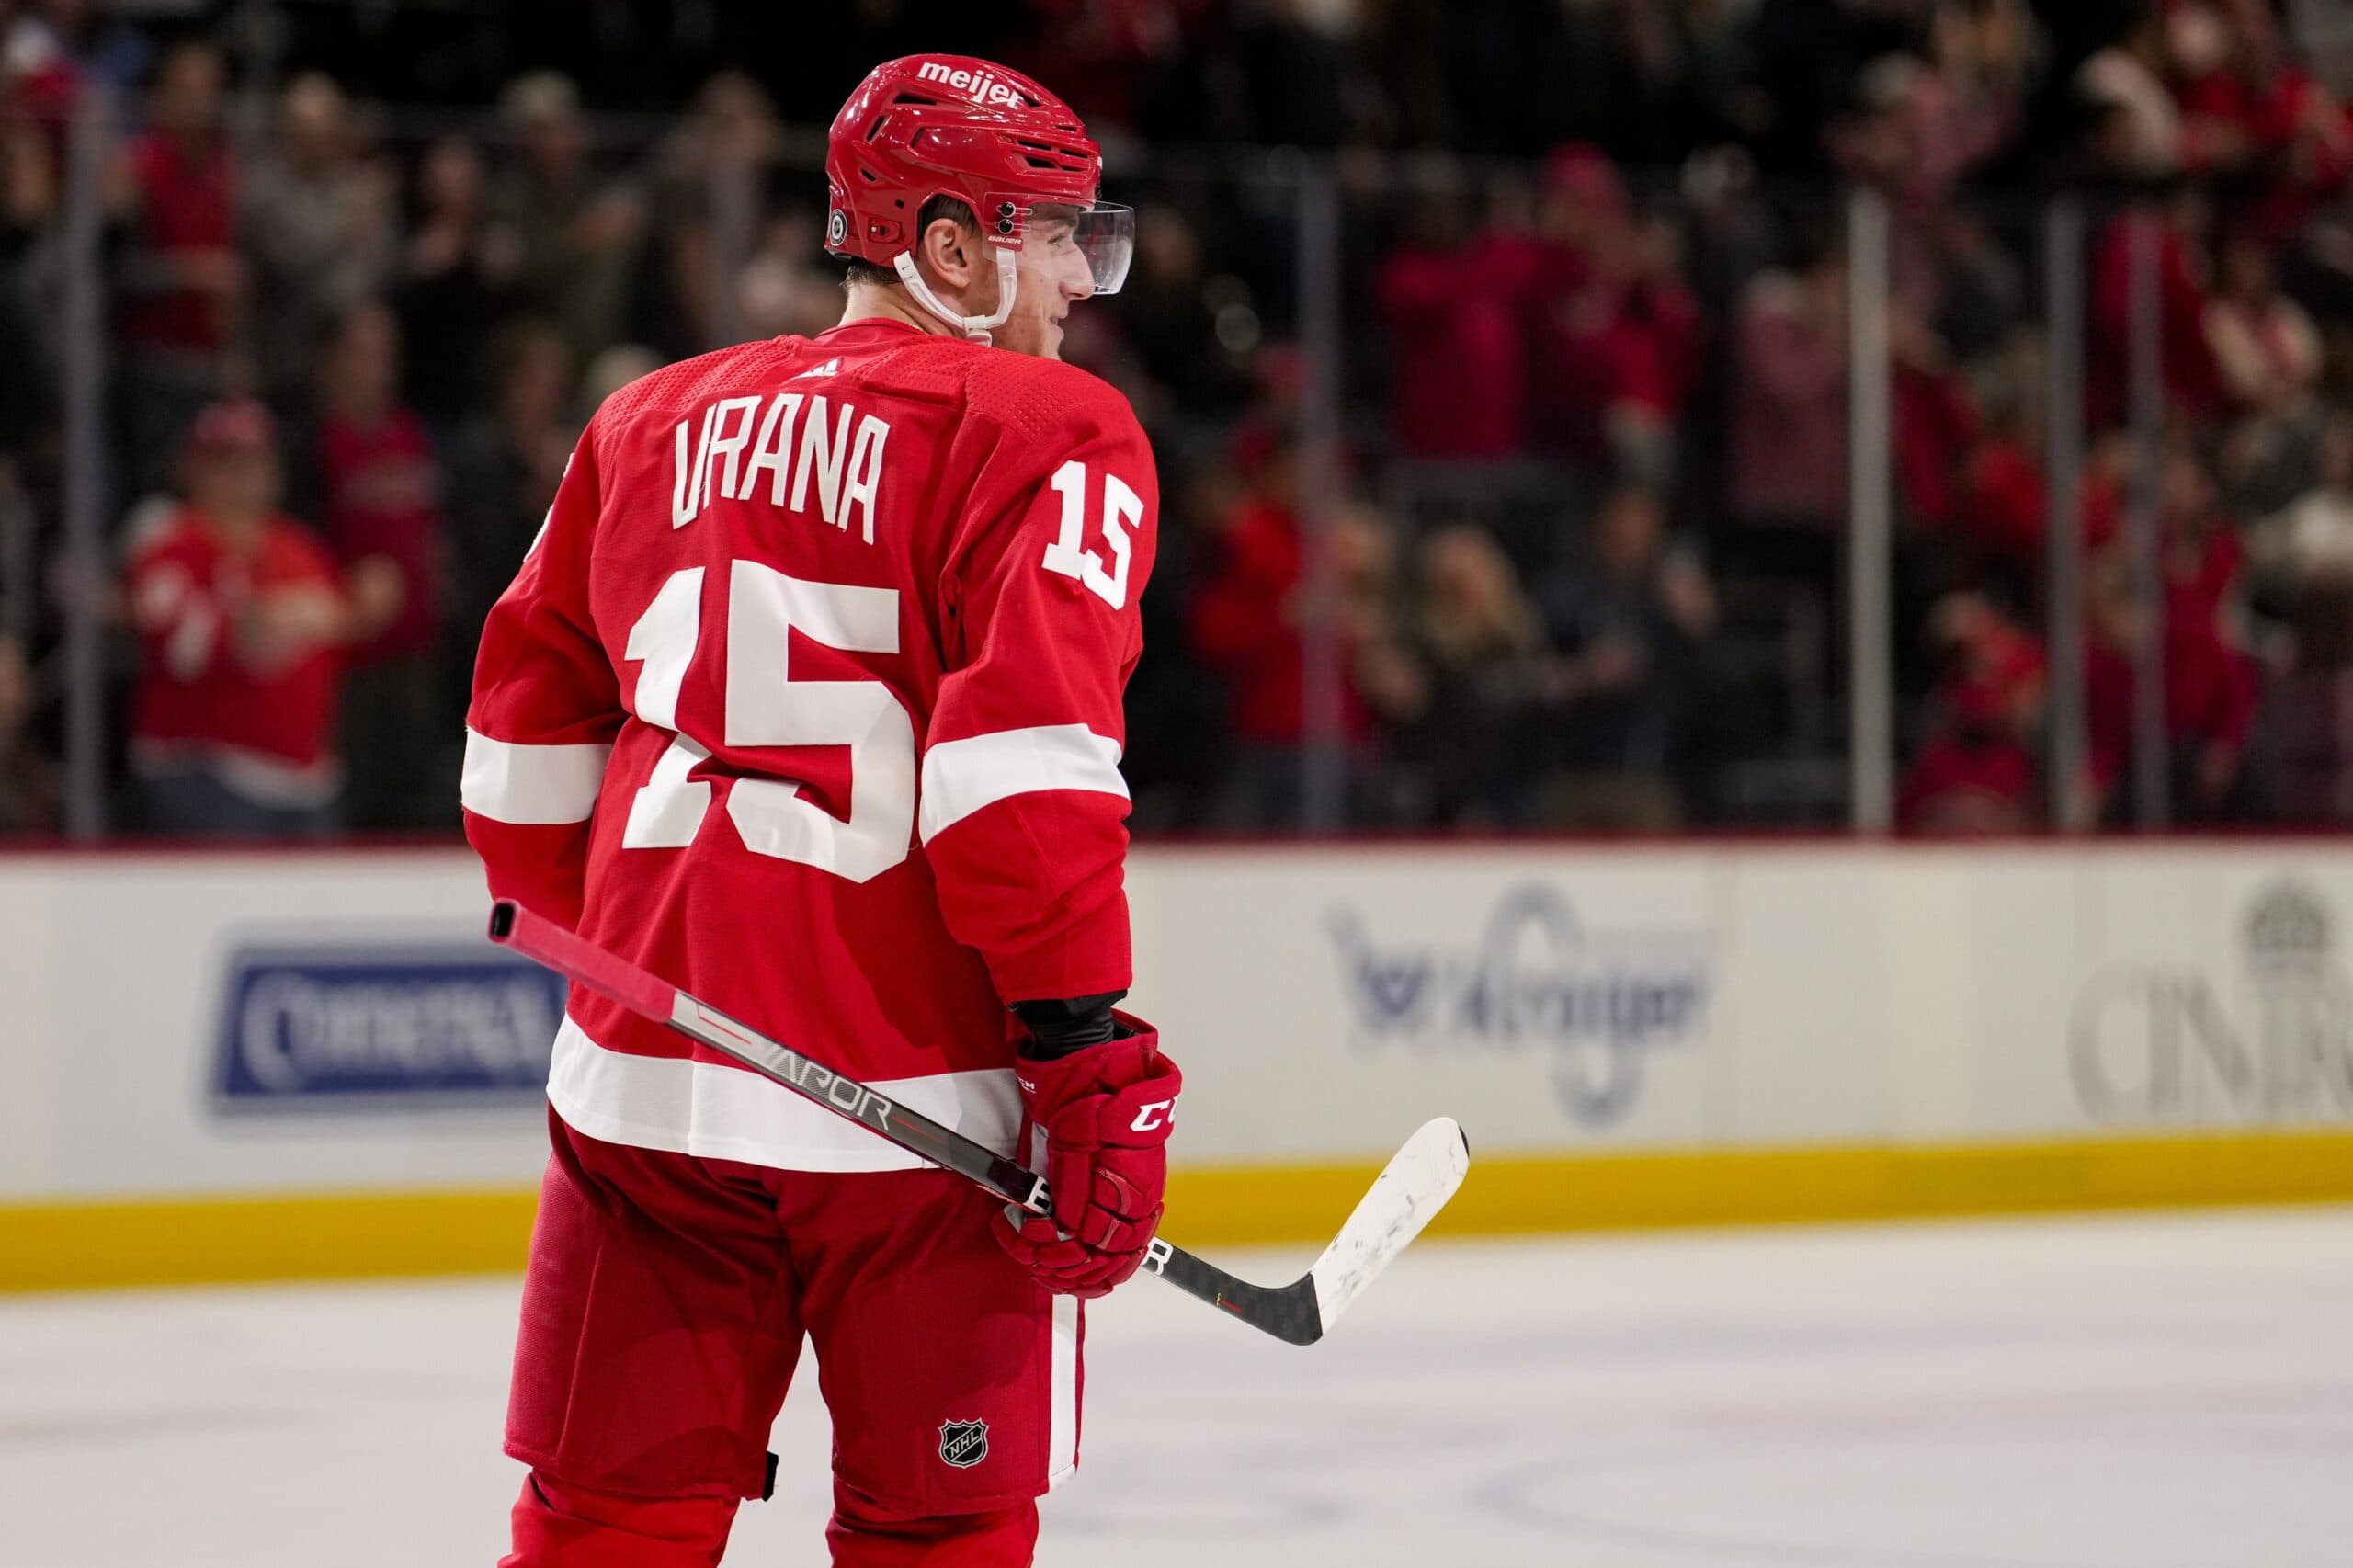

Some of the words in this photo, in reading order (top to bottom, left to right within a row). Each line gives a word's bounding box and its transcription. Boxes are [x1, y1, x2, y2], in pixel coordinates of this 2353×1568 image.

[917, 62, 1024, 110] meijer
[672, 393, 891, 545] VRANA
[1041, 460, 1144, 610] 15
[621, 559, 915, 883] 15
[949, 1431, 980, 1458] NHL
